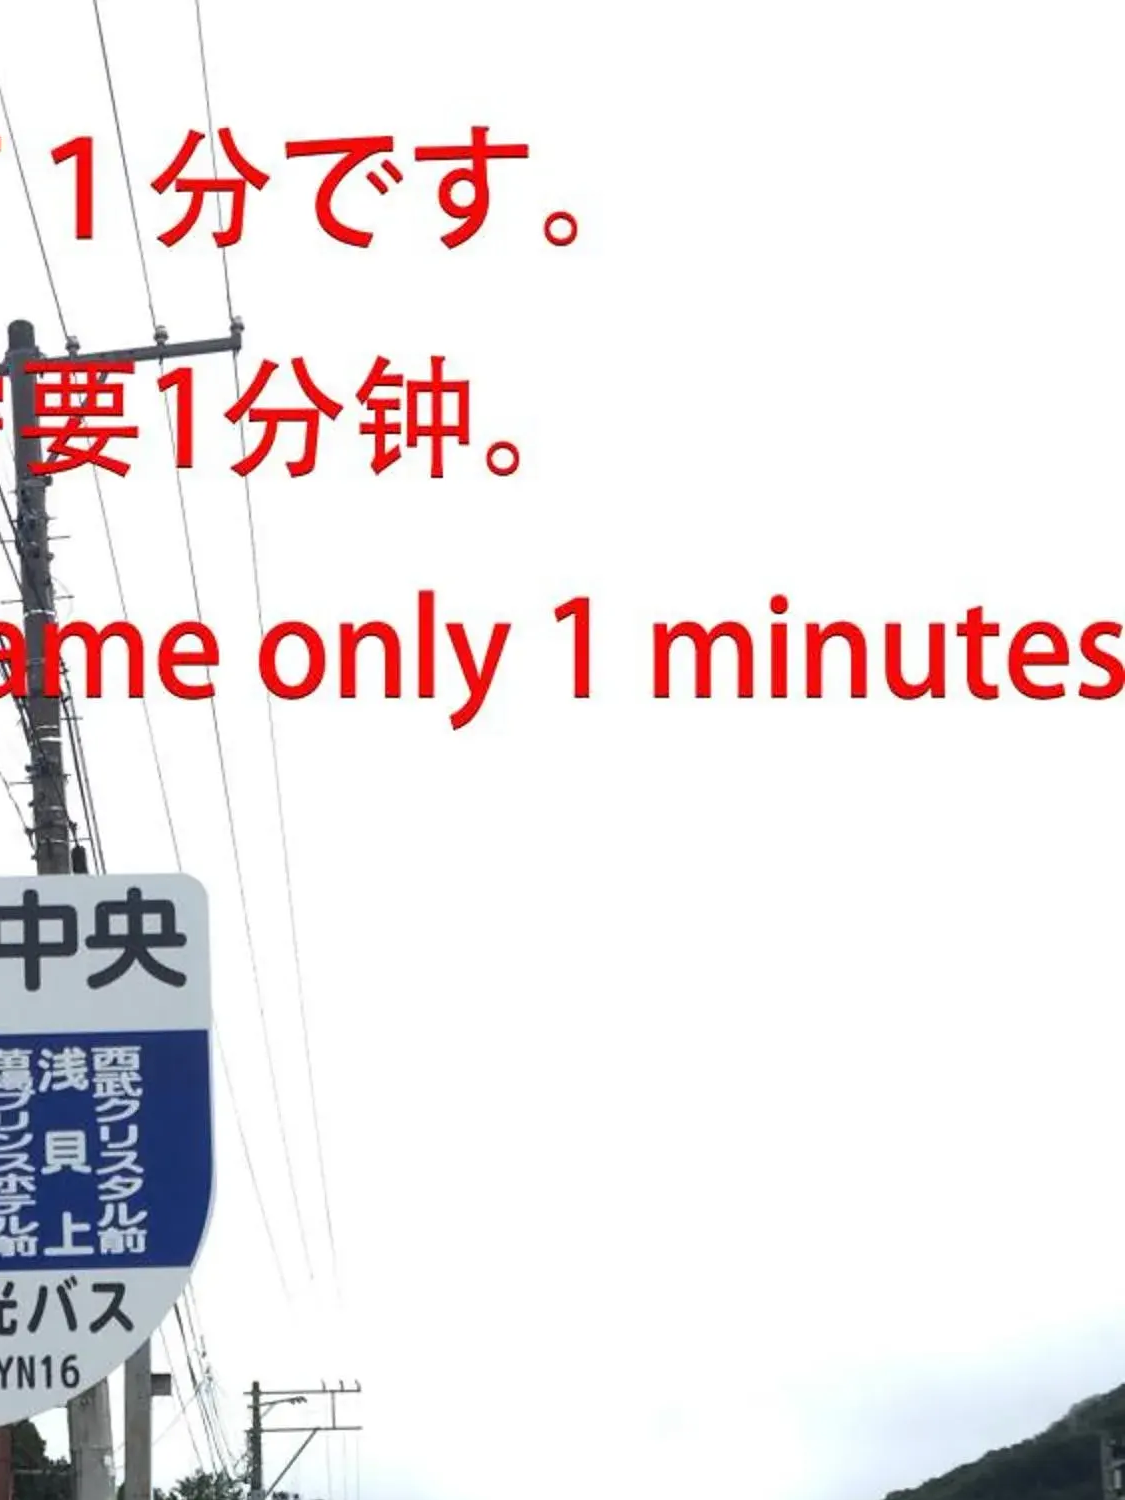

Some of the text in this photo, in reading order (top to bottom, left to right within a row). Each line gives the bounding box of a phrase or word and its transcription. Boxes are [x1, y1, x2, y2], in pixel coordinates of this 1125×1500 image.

[37, 1046, 94, 1256] 浅貝上
[91, 1046, 147, 1255] 西武クリスタル前
